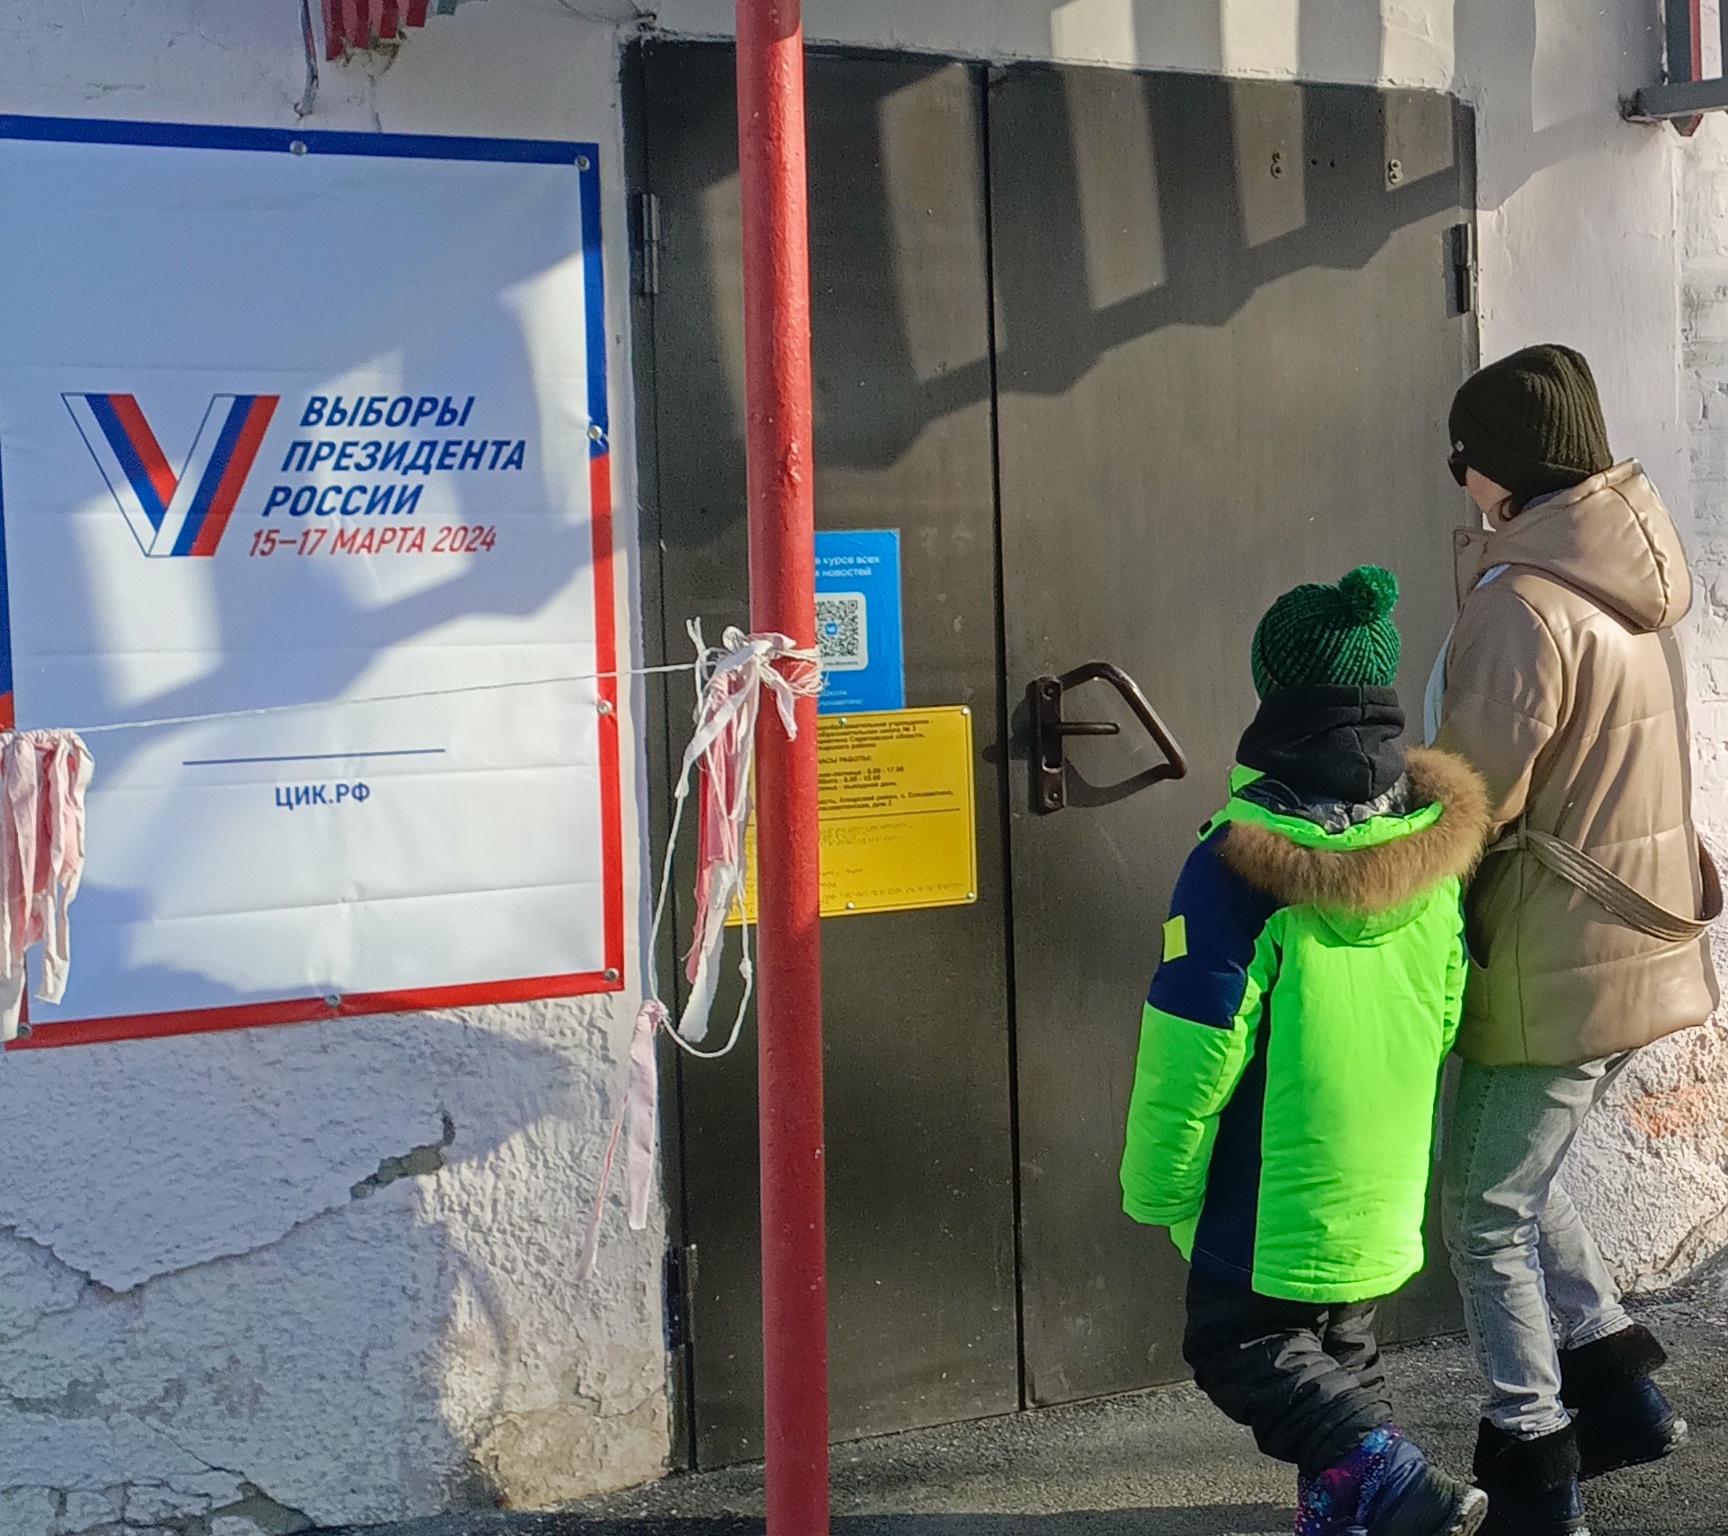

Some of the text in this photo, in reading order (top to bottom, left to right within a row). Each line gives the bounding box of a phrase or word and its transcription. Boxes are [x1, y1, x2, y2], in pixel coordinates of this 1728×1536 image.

[299, 395, 476, 428] ВЫБОРЫ
[280, 439, 527, 476] ПРЕЗИДЕНТА
[261, 483, 425, 518] РОССИИ
[329, 526, 427, 556] МАРТА
[431, 525, 498, 554] 2024
[275, 781, 371, 811] ЦИК.РФ
